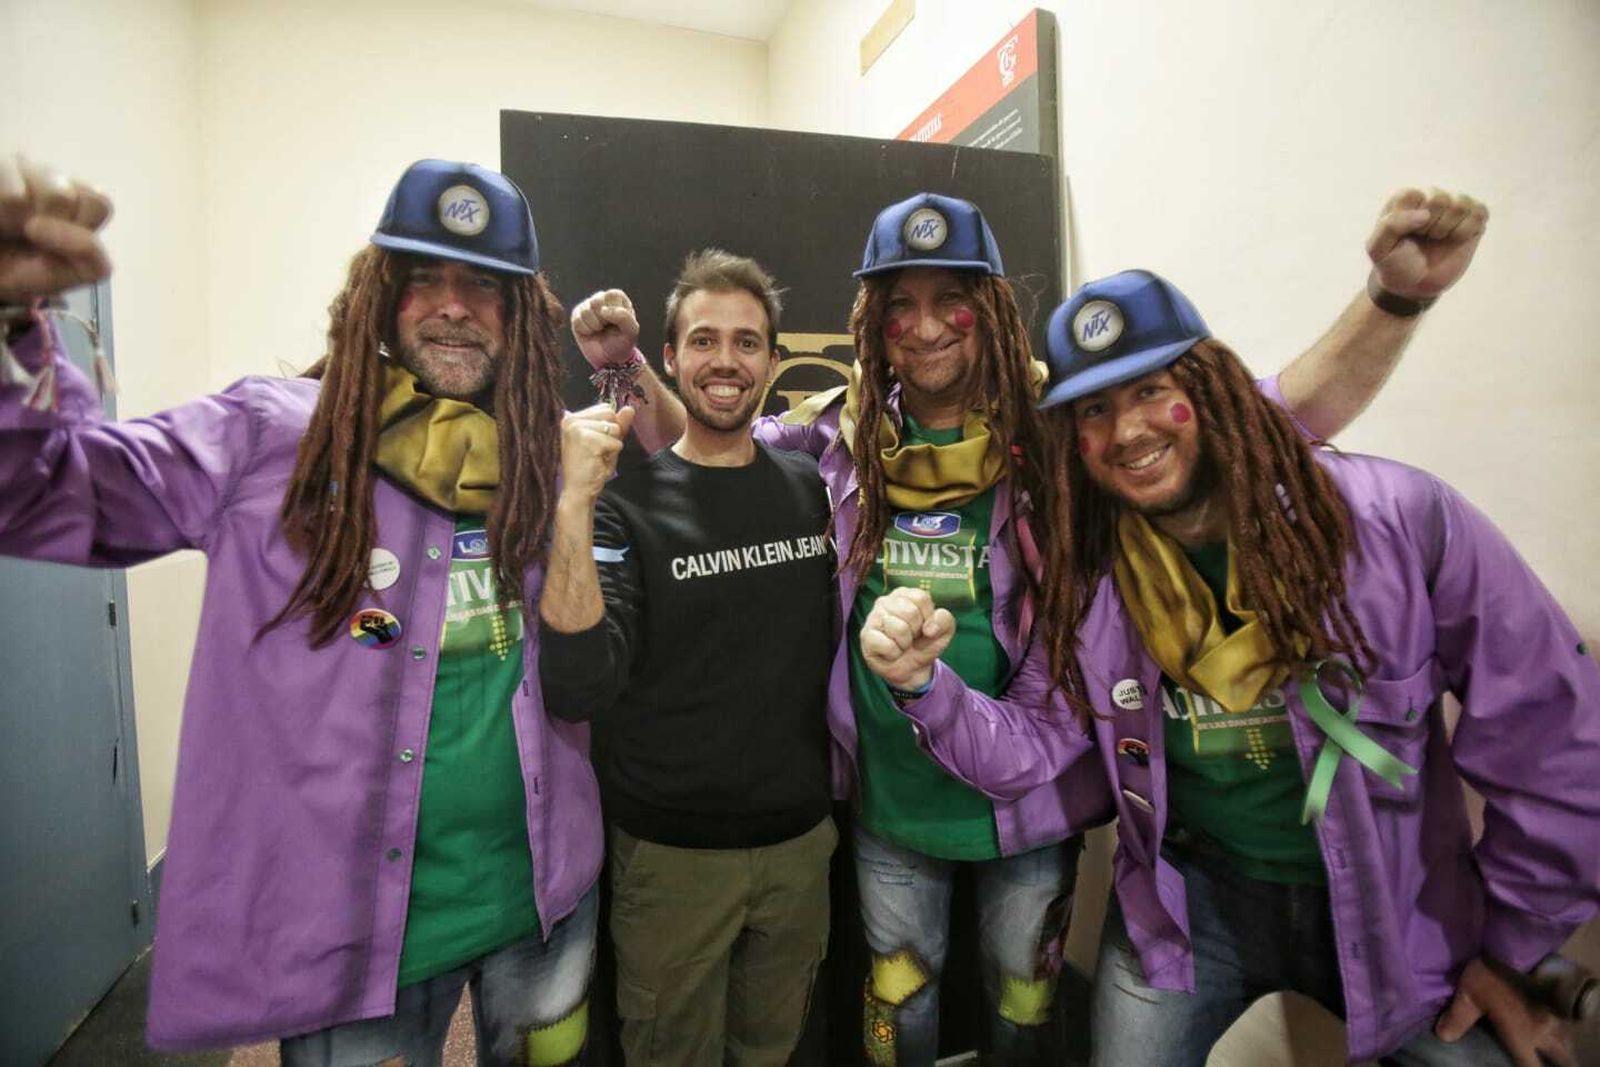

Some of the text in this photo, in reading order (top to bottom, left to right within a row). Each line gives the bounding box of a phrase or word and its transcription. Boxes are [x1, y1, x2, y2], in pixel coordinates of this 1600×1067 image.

[911, 219, 939, 239] NTX
[1083, 310, 1111, 342] NTX
[671, 535, 829, 581] CALVIN KLEIN JEAN
